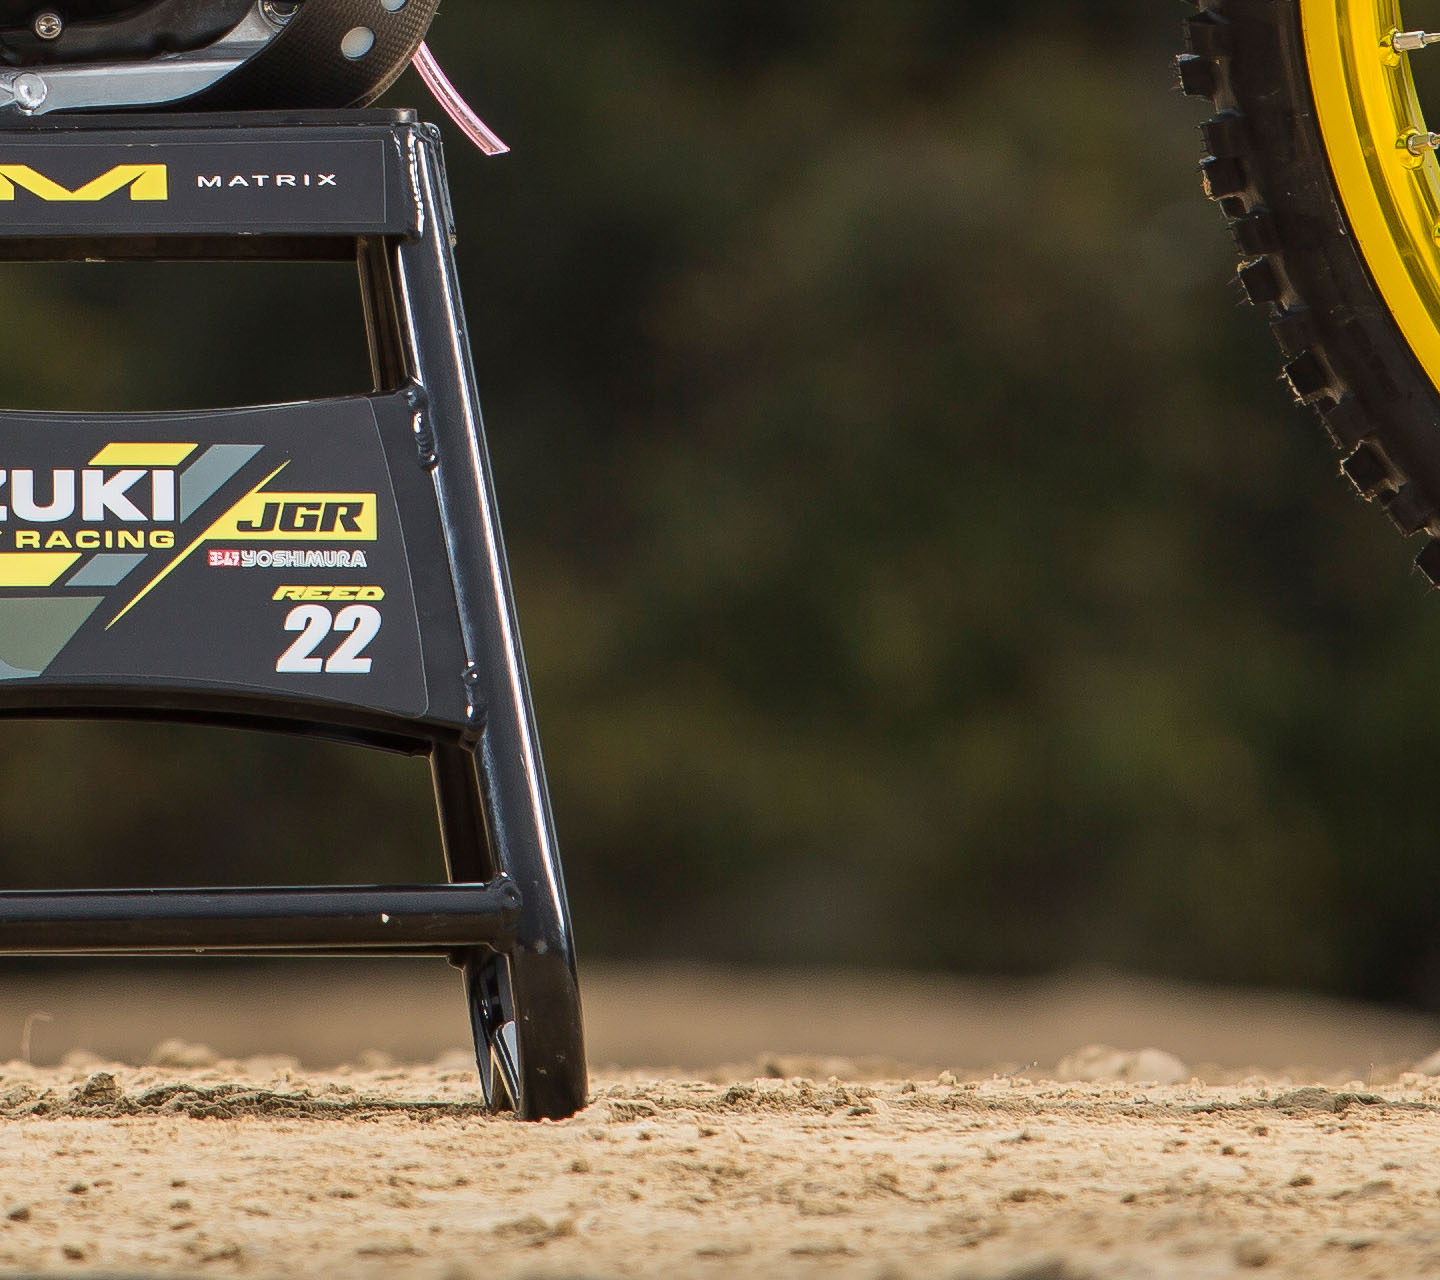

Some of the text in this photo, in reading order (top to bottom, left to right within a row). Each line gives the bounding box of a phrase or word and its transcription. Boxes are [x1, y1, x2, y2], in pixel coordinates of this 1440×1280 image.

[197, 172, 338, 189] MATRIX
[236, 502, 364, 533] JGR
[15, 529, 175, 550] RACING
[241, 550, 368, 568] YOSHIMURA
[272, 586, 386, 601] REED
[275, 603, 382, 674] 22
